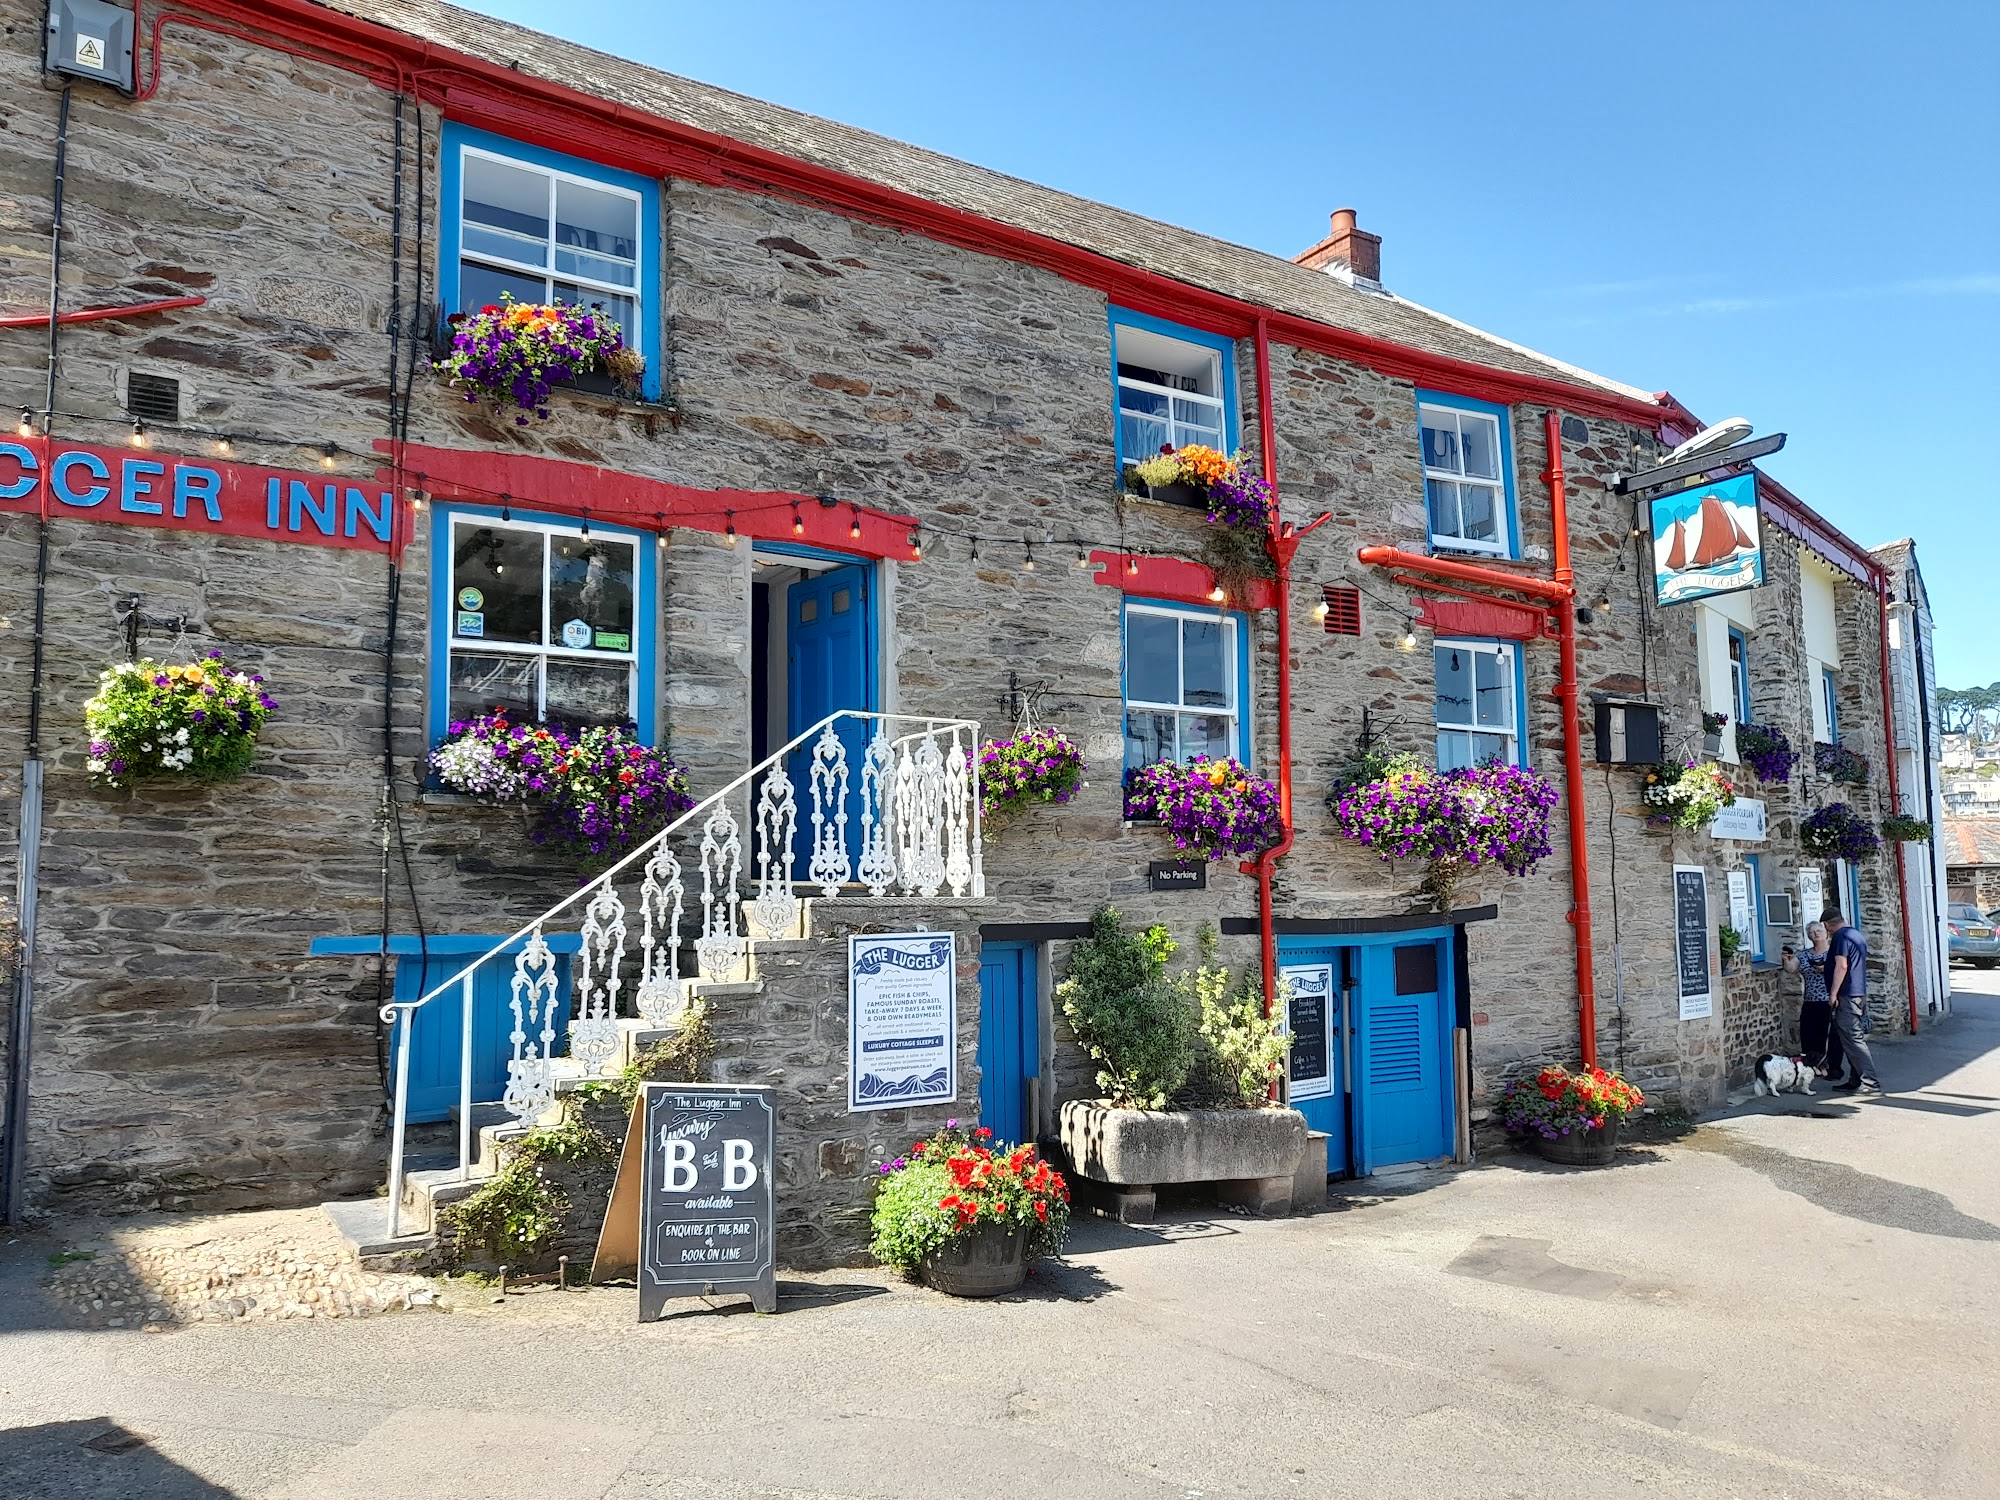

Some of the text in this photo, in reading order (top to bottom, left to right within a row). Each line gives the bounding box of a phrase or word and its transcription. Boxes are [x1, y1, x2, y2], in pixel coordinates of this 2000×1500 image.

[267, 477, 393, 542] INN
[1698, 574, 1748, 588] LUGGER
[1160, 870, 1197, 880] No Parking
[864, 948, 941, 970] THE LUGGER
[1289, 976, 1324, 992] THE LUGGER
[864, 1007, 899, 1015] TAKE-AWAY
[866, 1000, 893, 1008] FAMOUS
[904, 1012, 942, 1020] READYMEALS
[867, 1042, 891, 1050] LUXURY
[890, 1040, 916, 1048] COTTAGE
[674, 1096, 742, 1111] The Lugger Inn
[658, 1119, 717, 1151] luxury
[660, 1138, 699, 1193] B
[720, 1138, 758, 1192] B
[684, 1195, 734, 1209] available
[665, 1223, 750, 1238] ENQUIRE AT THE BAR
[681, 1247, 741, 1262] BOOK ON LINE
